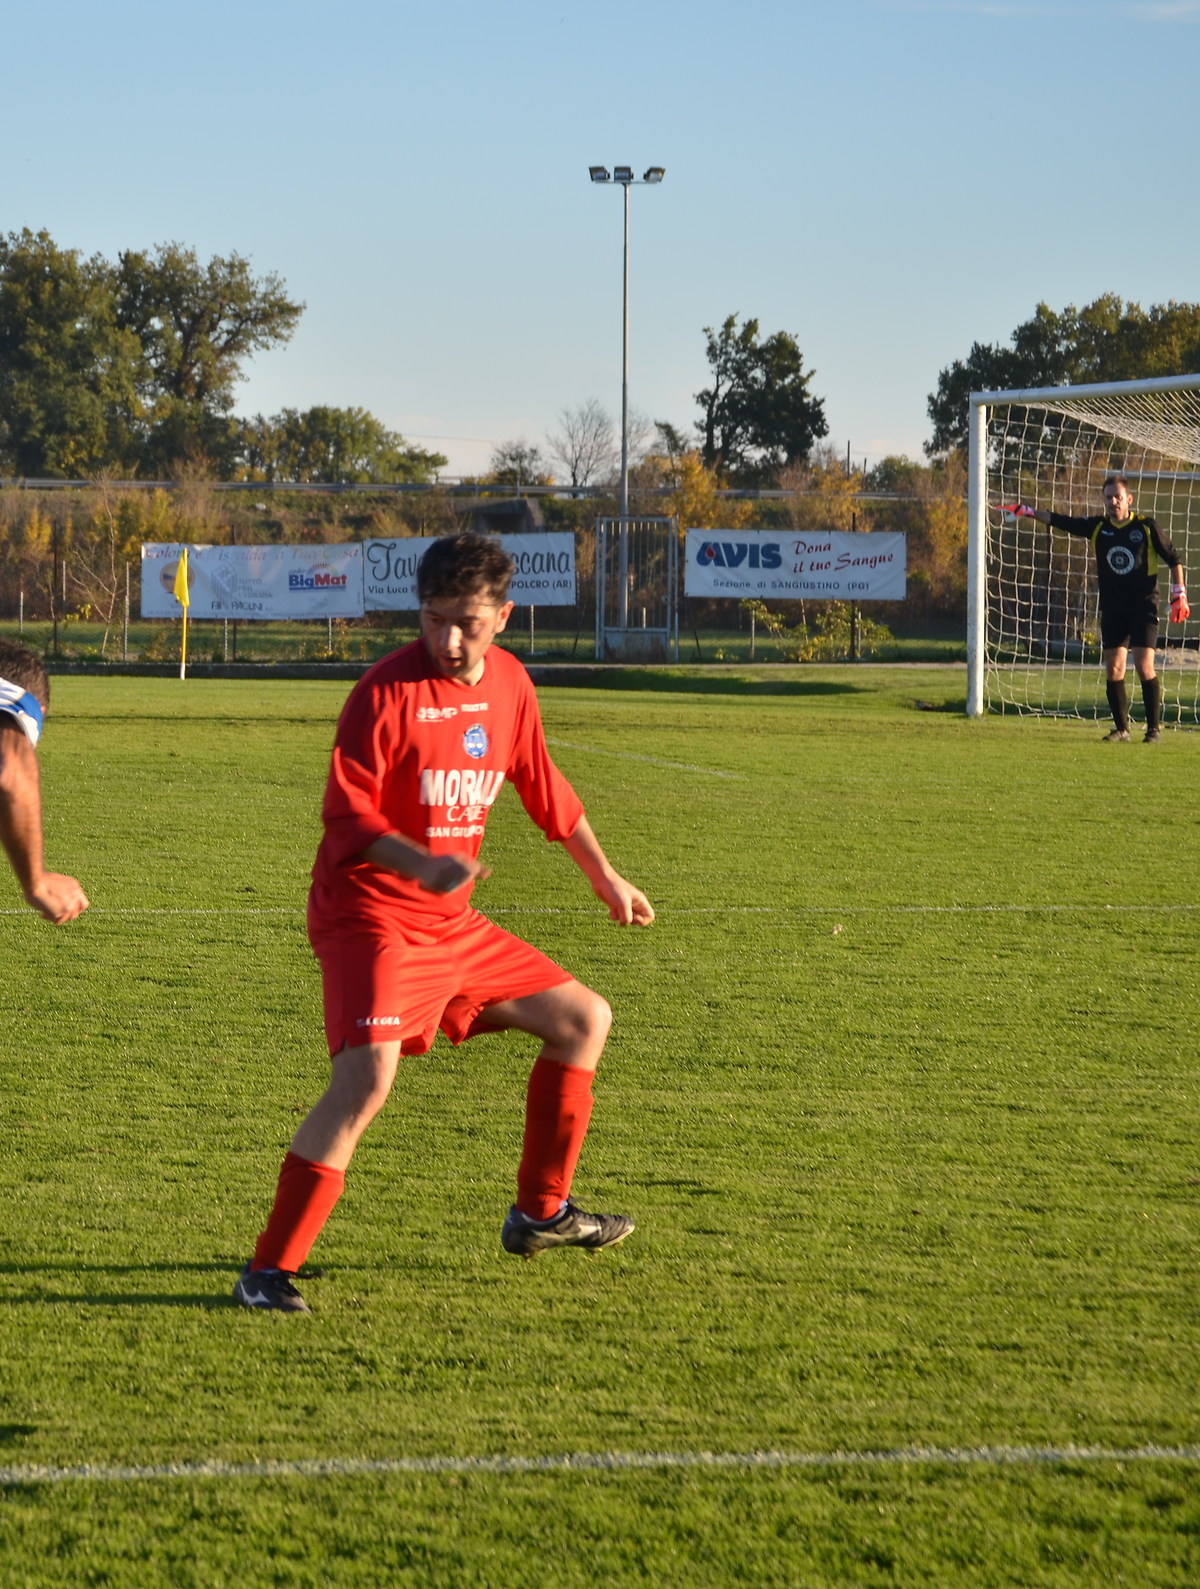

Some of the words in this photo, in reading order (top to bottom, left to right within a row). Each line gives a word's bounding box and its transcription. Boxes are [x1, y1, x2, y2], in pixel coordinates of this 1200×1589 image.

[792, 540, 832, 555] Dona
[696, 541, 783, 569] AVIS
[793, 562, 805, 574] il
[809, 559, 832, 571] tuo
[833, 552, 894, 571] Sangue
[288, 573, 347, 590] BigMat
[552, 578, 572, 590] (AR)
[713, 578, 751, 588] Sezione
[757, 578, 767, 588] di
[847, 581, 870, 591] (PG)
[368, 585, 385, 594] Via
[387, 584, 408, 594] Luca
[426, 827, 451, 838] SAN
